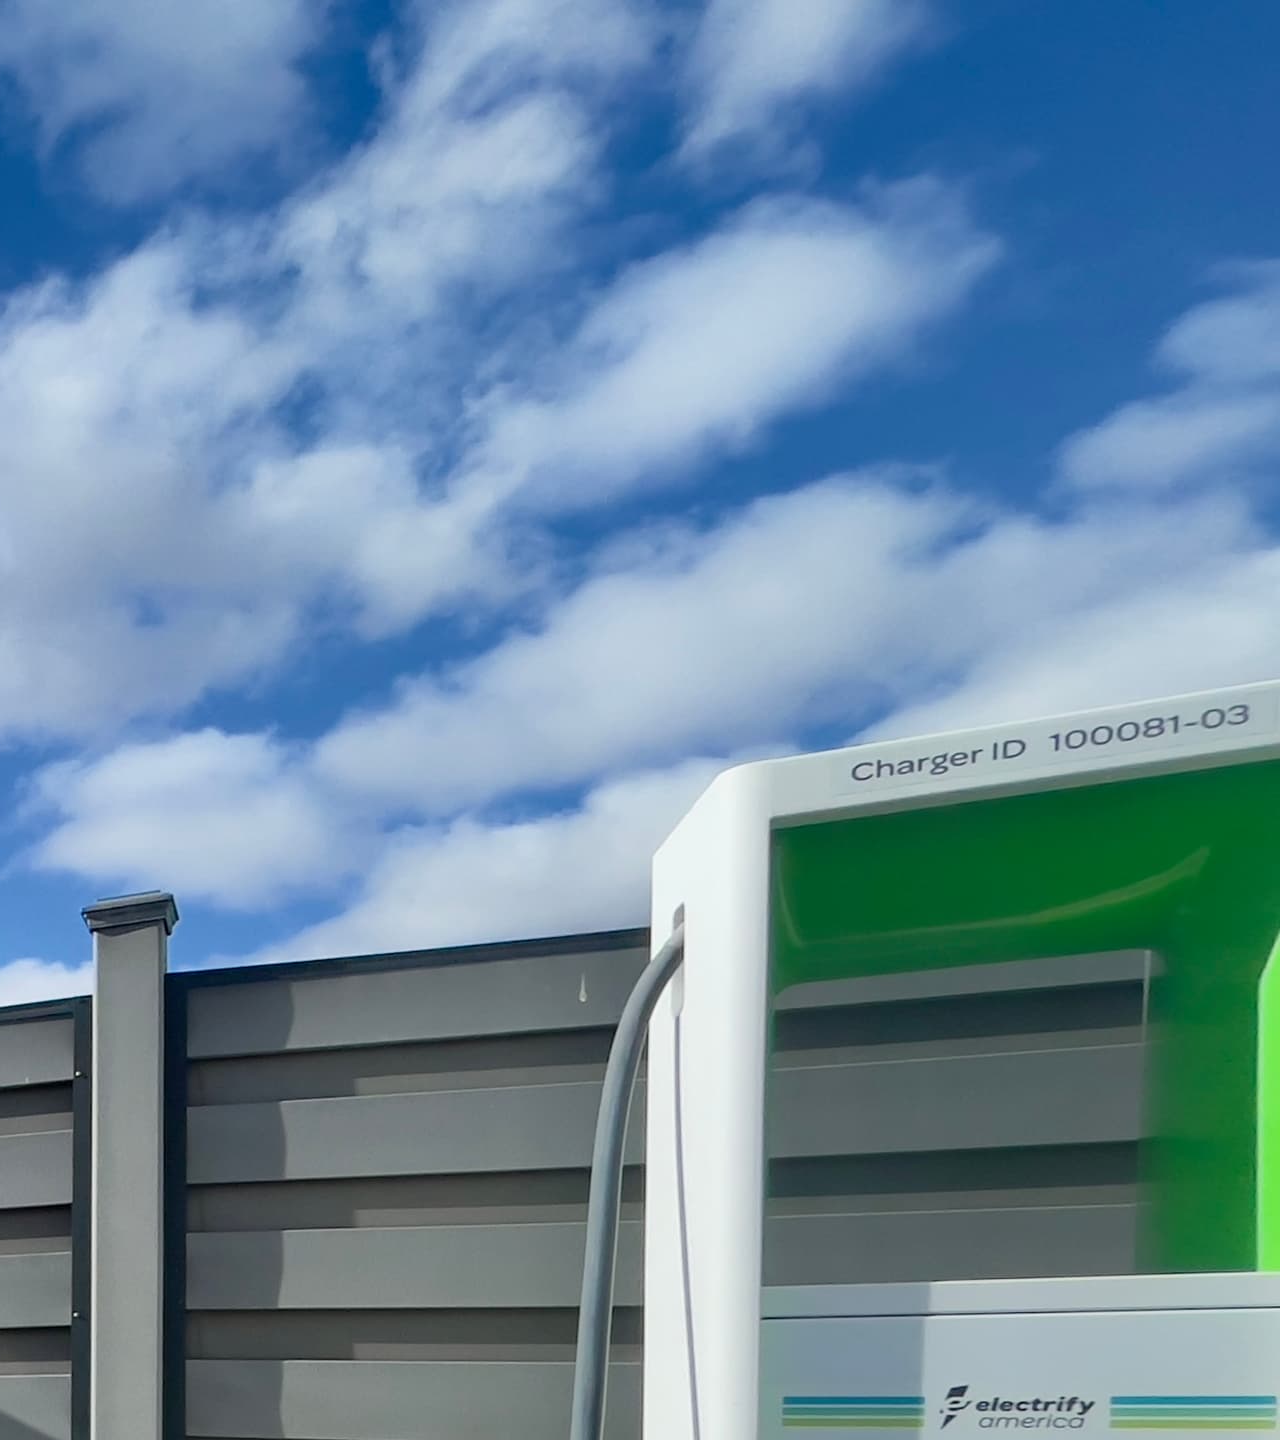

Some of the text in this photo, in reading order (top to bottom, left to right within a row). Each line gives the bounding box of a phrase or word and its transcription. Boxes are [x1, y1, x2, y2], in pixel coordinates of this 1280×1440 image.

[851, 703, 1250, 781] Charger ID 100081-03
[975, 1396, 1095, 1416] electrify
[978, 1414, 1085, 1429] america
